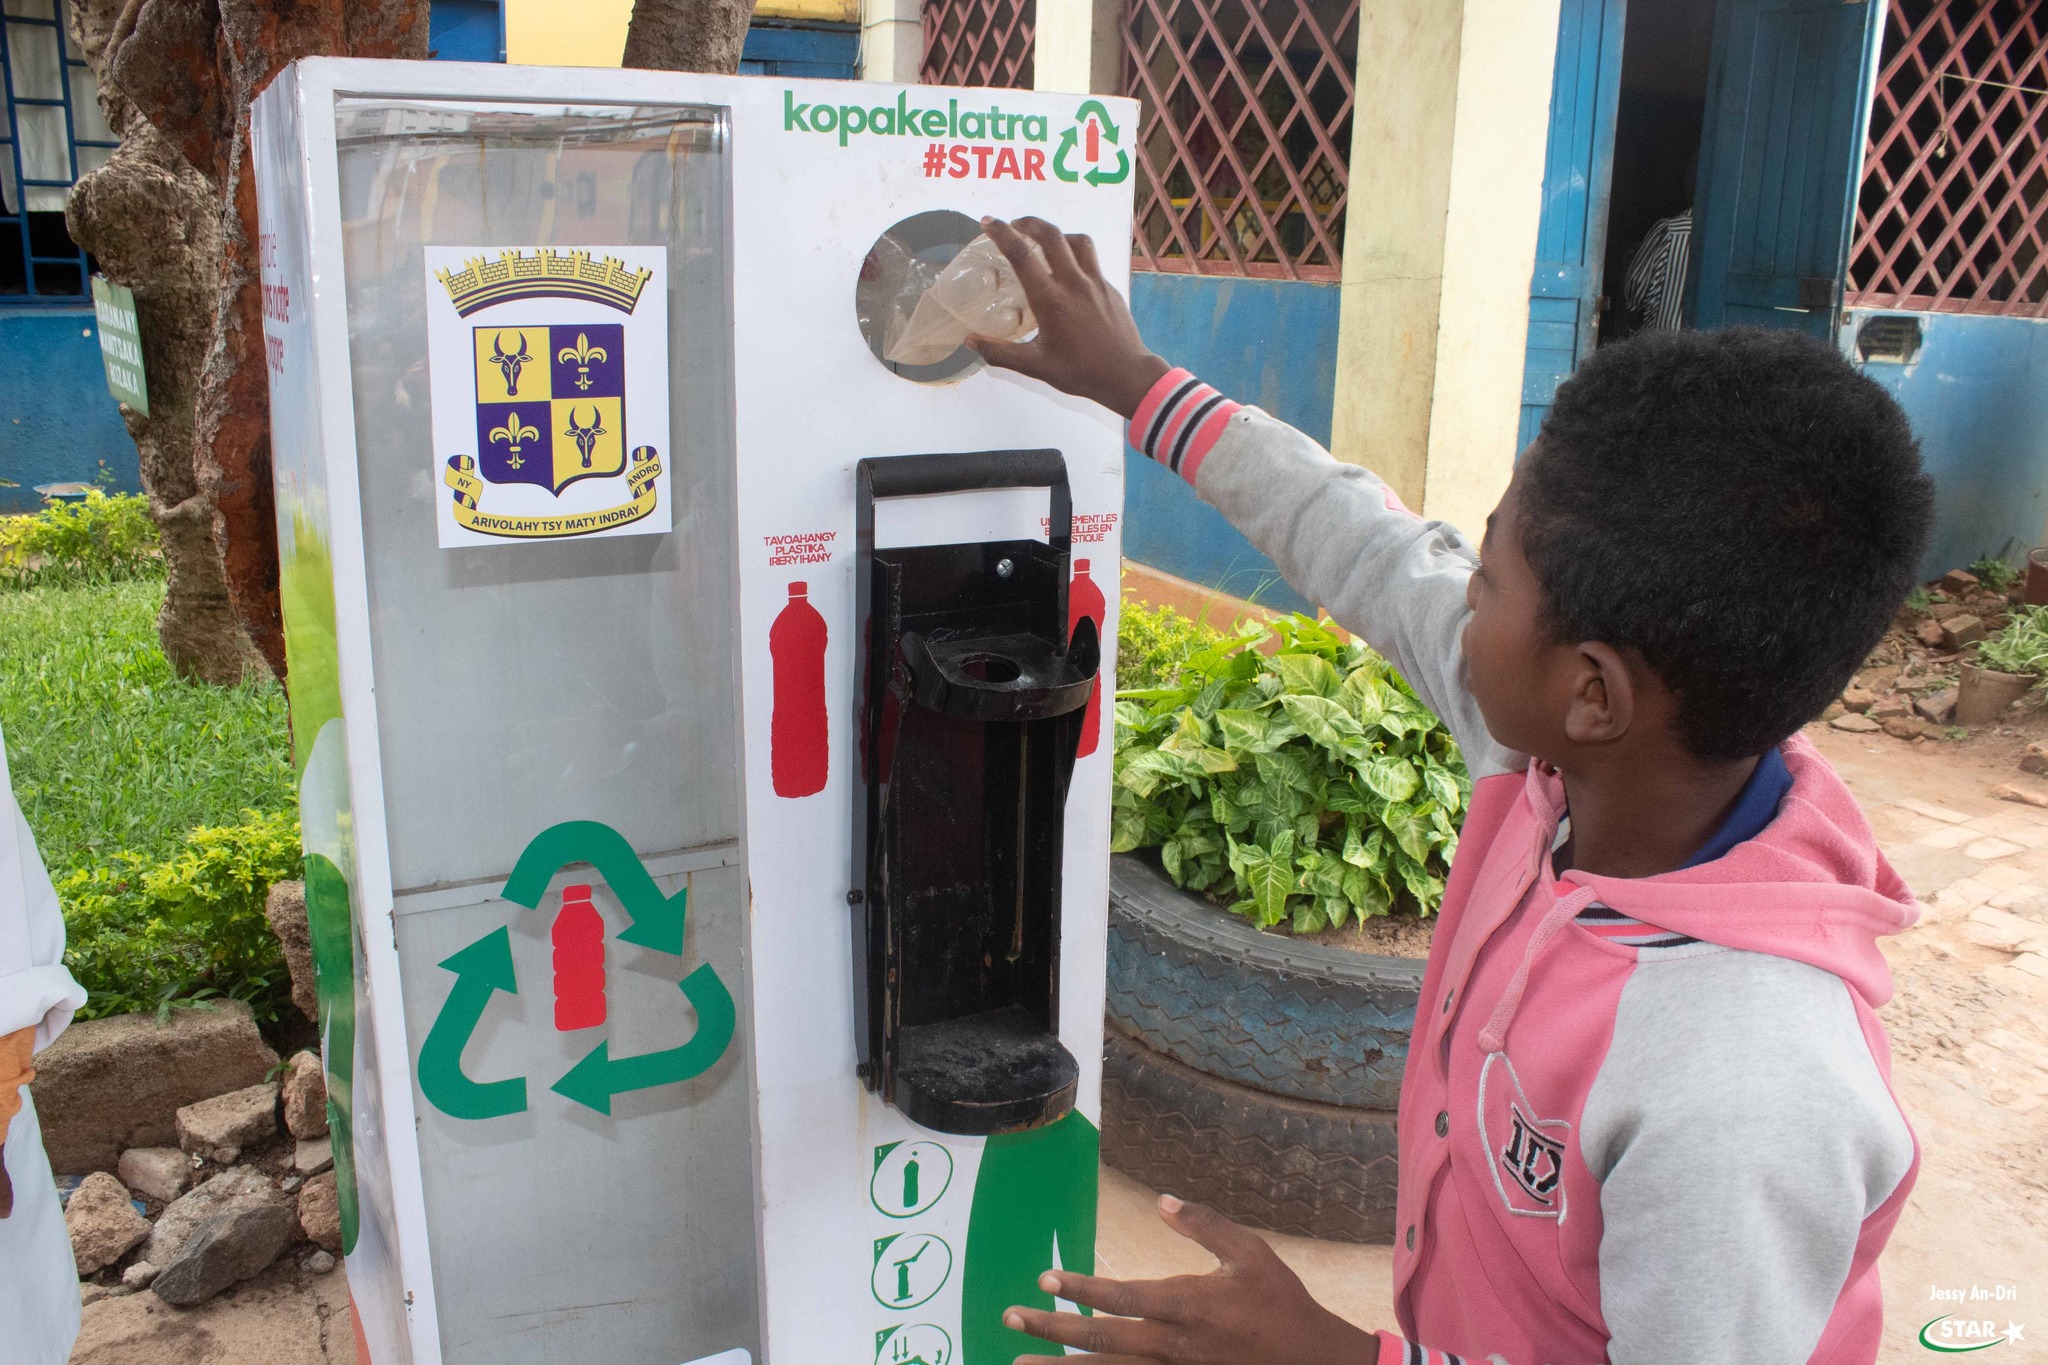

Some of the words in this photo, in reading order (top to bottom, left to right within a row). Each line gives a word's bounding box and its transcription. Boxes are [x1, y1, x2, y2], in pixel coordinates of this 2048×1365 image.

[784, 89, 1048, 147] kopakelatra
[922, 143, 1047, 182] #STAR
[456, 477, 473, 490] NY
[471, 515, 540, 532] ARIVOLAHY
[541, 520, 563, 531] TSY
[565, 516, 597, 530] MATY
[599, 505, 640, 525] INDRAY
[627, 462, 660, 487] ANDRO
[1101, 513, 1118, 523] LES
[1100, 523, 1112, 533] EN
[763, 531, 837, 547] TAVOAHANGY
[775, 543, 826, 556] PLASTIKA
[769, 555, 799, 567] IRERY
[800, 552, 832, 564] IHANY
